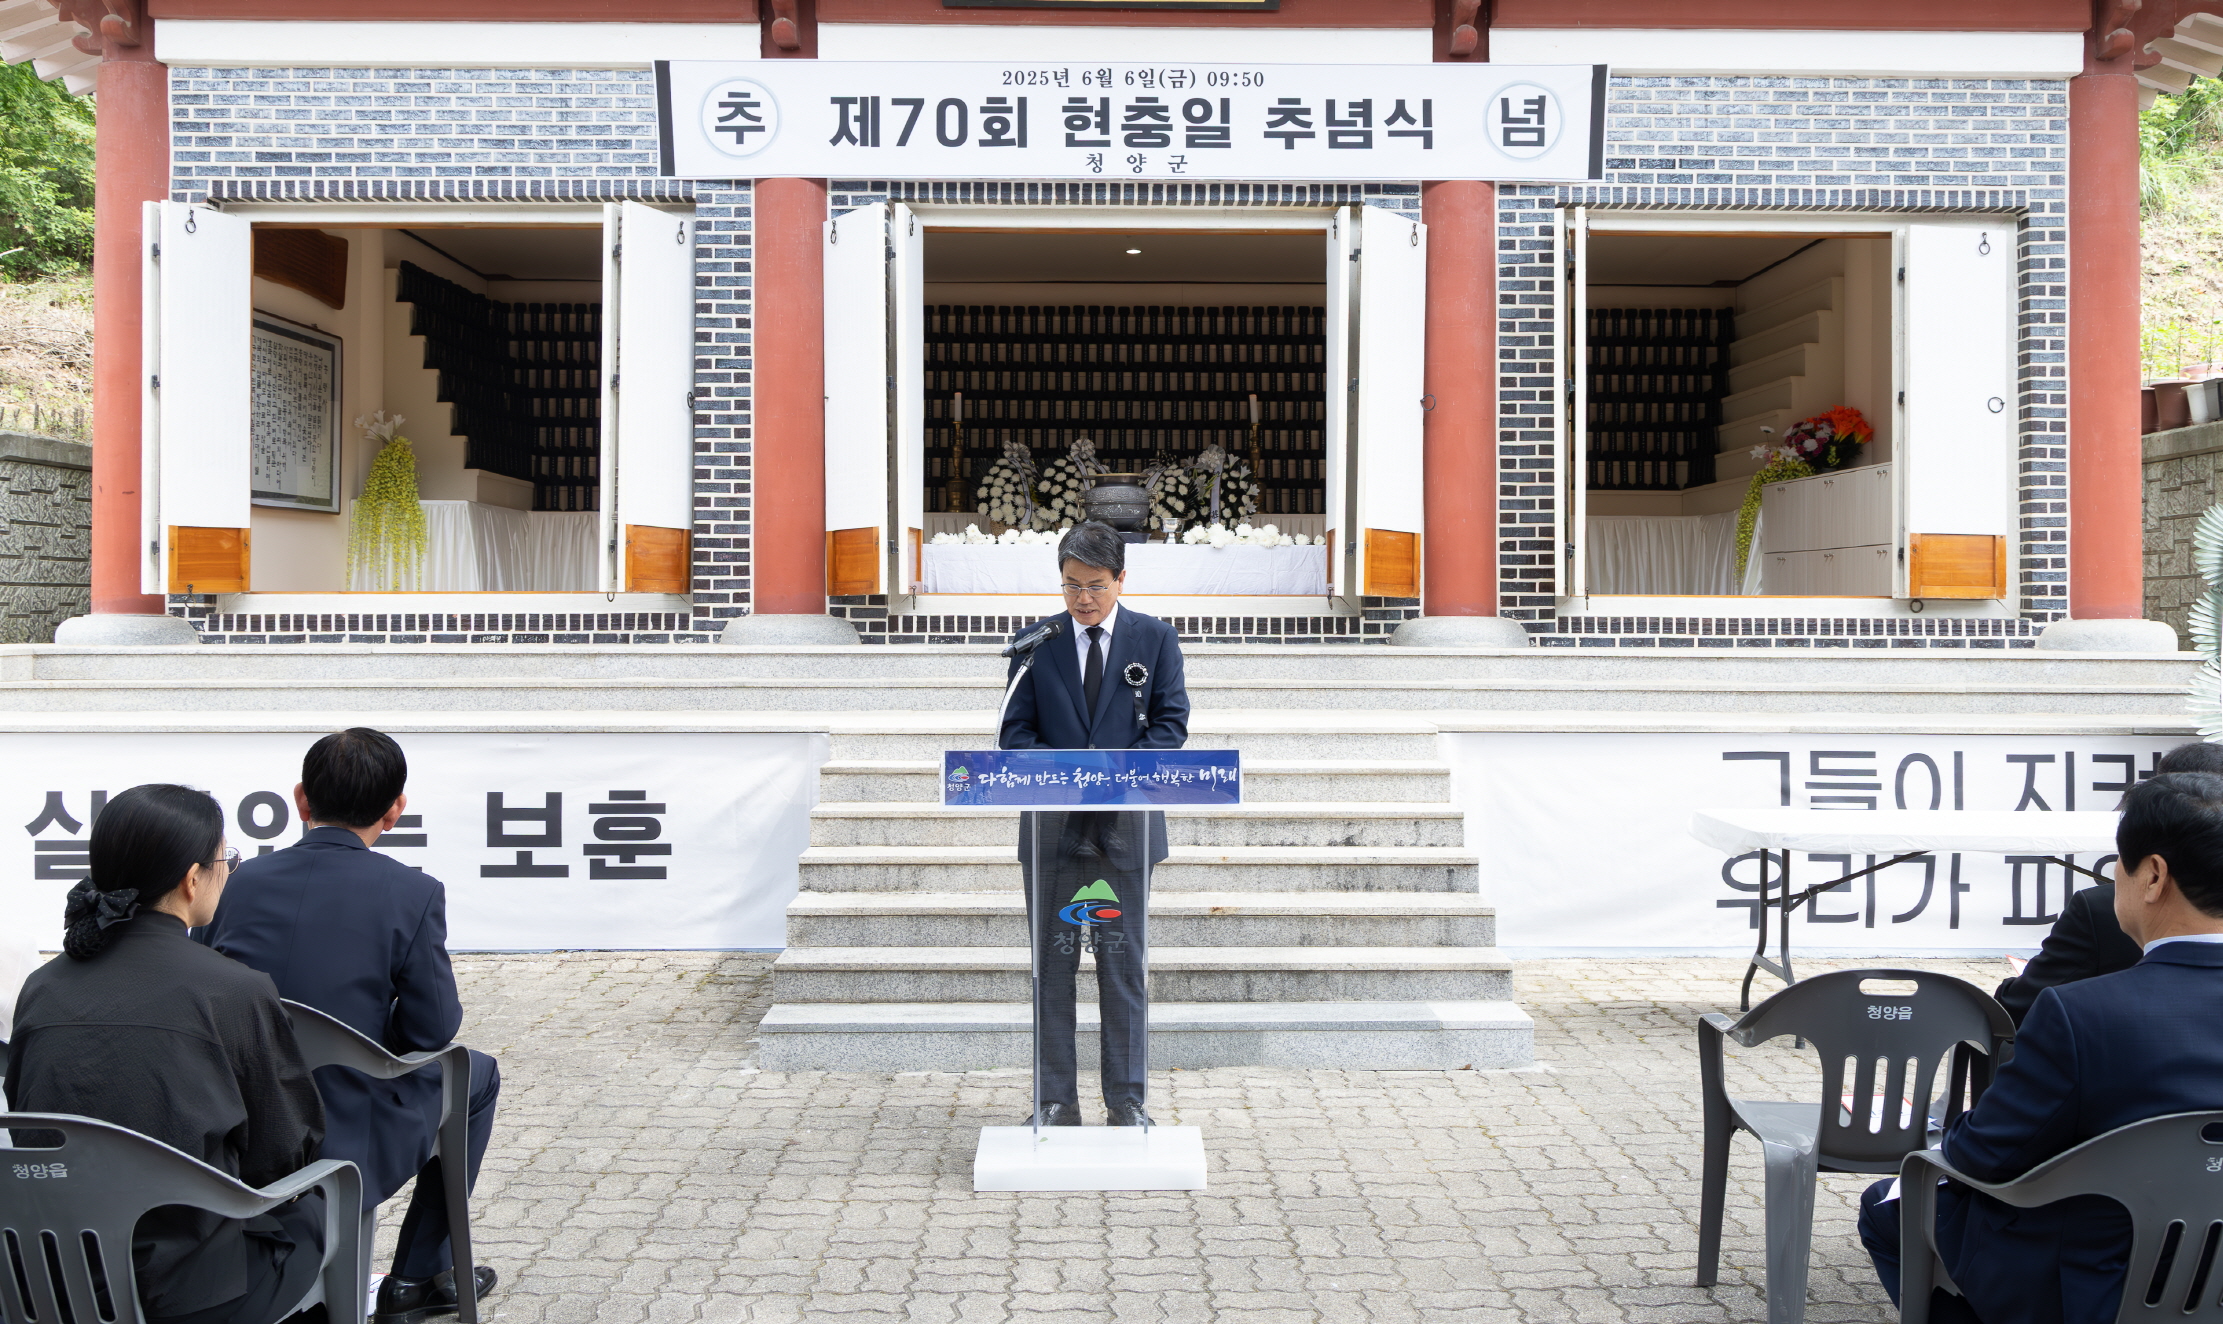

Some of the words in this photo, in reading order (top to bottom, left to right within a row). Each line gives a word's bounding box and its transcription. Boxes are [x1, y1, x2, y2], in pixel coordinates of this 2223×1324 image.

[1002, 68, 1070, 89] 2025년
[1082, 67, 1113, 89] 6월
[1125, 67, 1196, 89] 6일(금)
[1207, 70, 1264, 87] 09:50
[715, 91, 766, 145] 추
[829, 95, 1027, 149] 제70회
[1062, 96, 1232, 149] 현충일
[1263, 97, 1433, 150] 추념식
[1500, 95, 1547, 147] 념
[946, 783, 971, 792] 청양군
[978, 765, 1031, 788] 다함께
[1035, 770, 1069, 786] 만드는
[1115, 768, 1149, 788] 더불어
[1152, 769, 1195, 788] 행복한
[1199, 765, 1238, 792] 미래
[480, 790, 672, 880] 보훈
[1716, 850, 1971, 930] 우리가
[1053, 931, 1129, 955] 청양군
[1867, 1005, 1913, 1021] 청양읍
[12, 1163, 68, 1179] 청양읍
